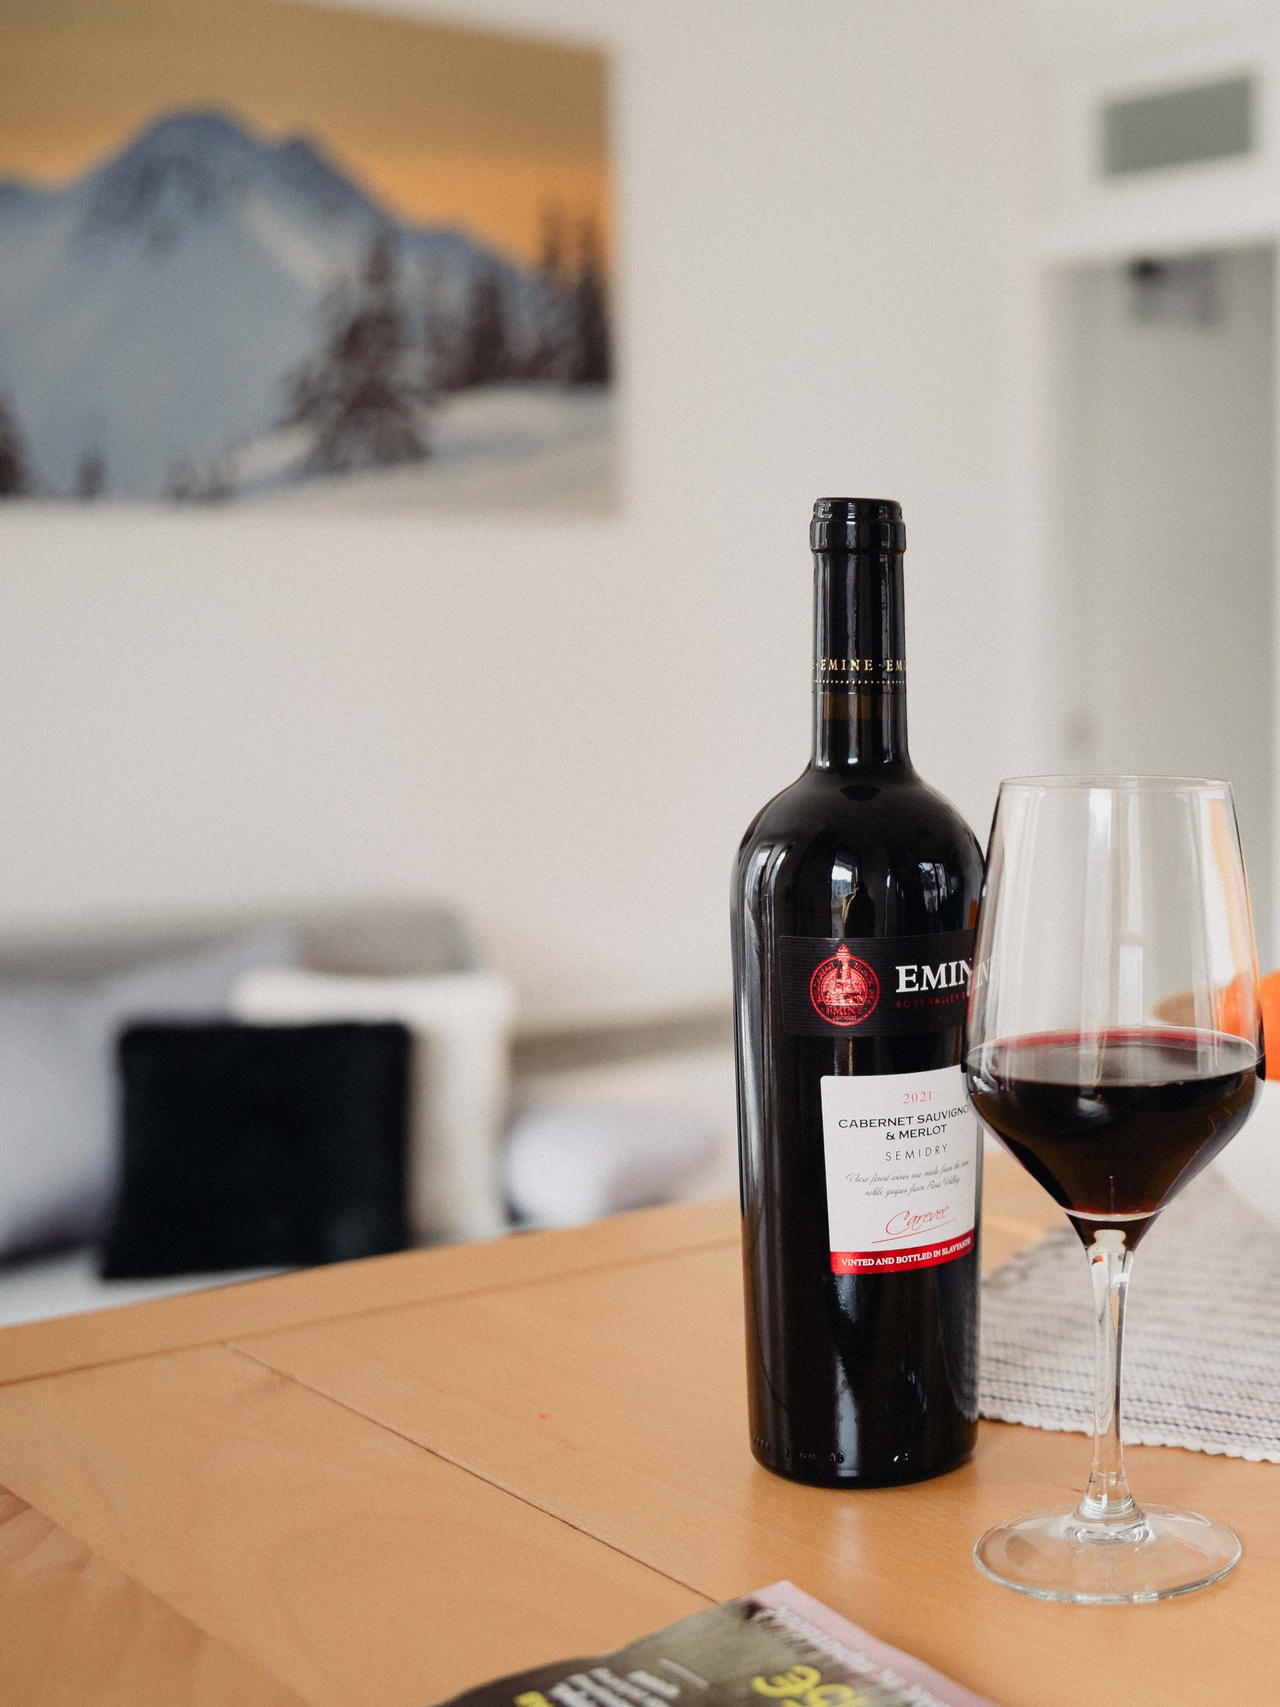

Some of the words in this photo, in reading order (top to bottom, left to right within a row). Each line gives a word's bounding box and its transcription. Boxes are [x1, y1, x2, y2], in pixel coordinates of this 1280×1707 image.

[820, 659, 873, 671] EMINE
[895, 957, 991, 993] EMIN
[928, 992, 960, 1005] VALLEY
[825, 1006, 863, 1015] EMINE
[903, 1090, 933, 1104] 2021
[838, 1116, 914, 1128] CABERNET
[917, 1104, 971, 1123] SAUVIGNO
[886, 1131, 895, 1140] &
[899, 1124, 947, 1139] MERLOT
[885, 1144, 948, 1161] SEMIDRY
[845, 1173, 867, 1183] These
[869, 1173, 888, 1185] finest
[924, 1166, 939, 1176] made
[864, 1187, 882, 1196] noble
[908, 1183, 925, 1196] from
[927, 1180, 941, 1190] Rose
[943, 1175, 960, 1187] Valley
[841, 1259, 874, 1267] VINTED
[876, 1257, 895, 1266] AND
[896, 1251, 932, 1264] BOTTLED
[933, 1250, 941, 1258] IN
